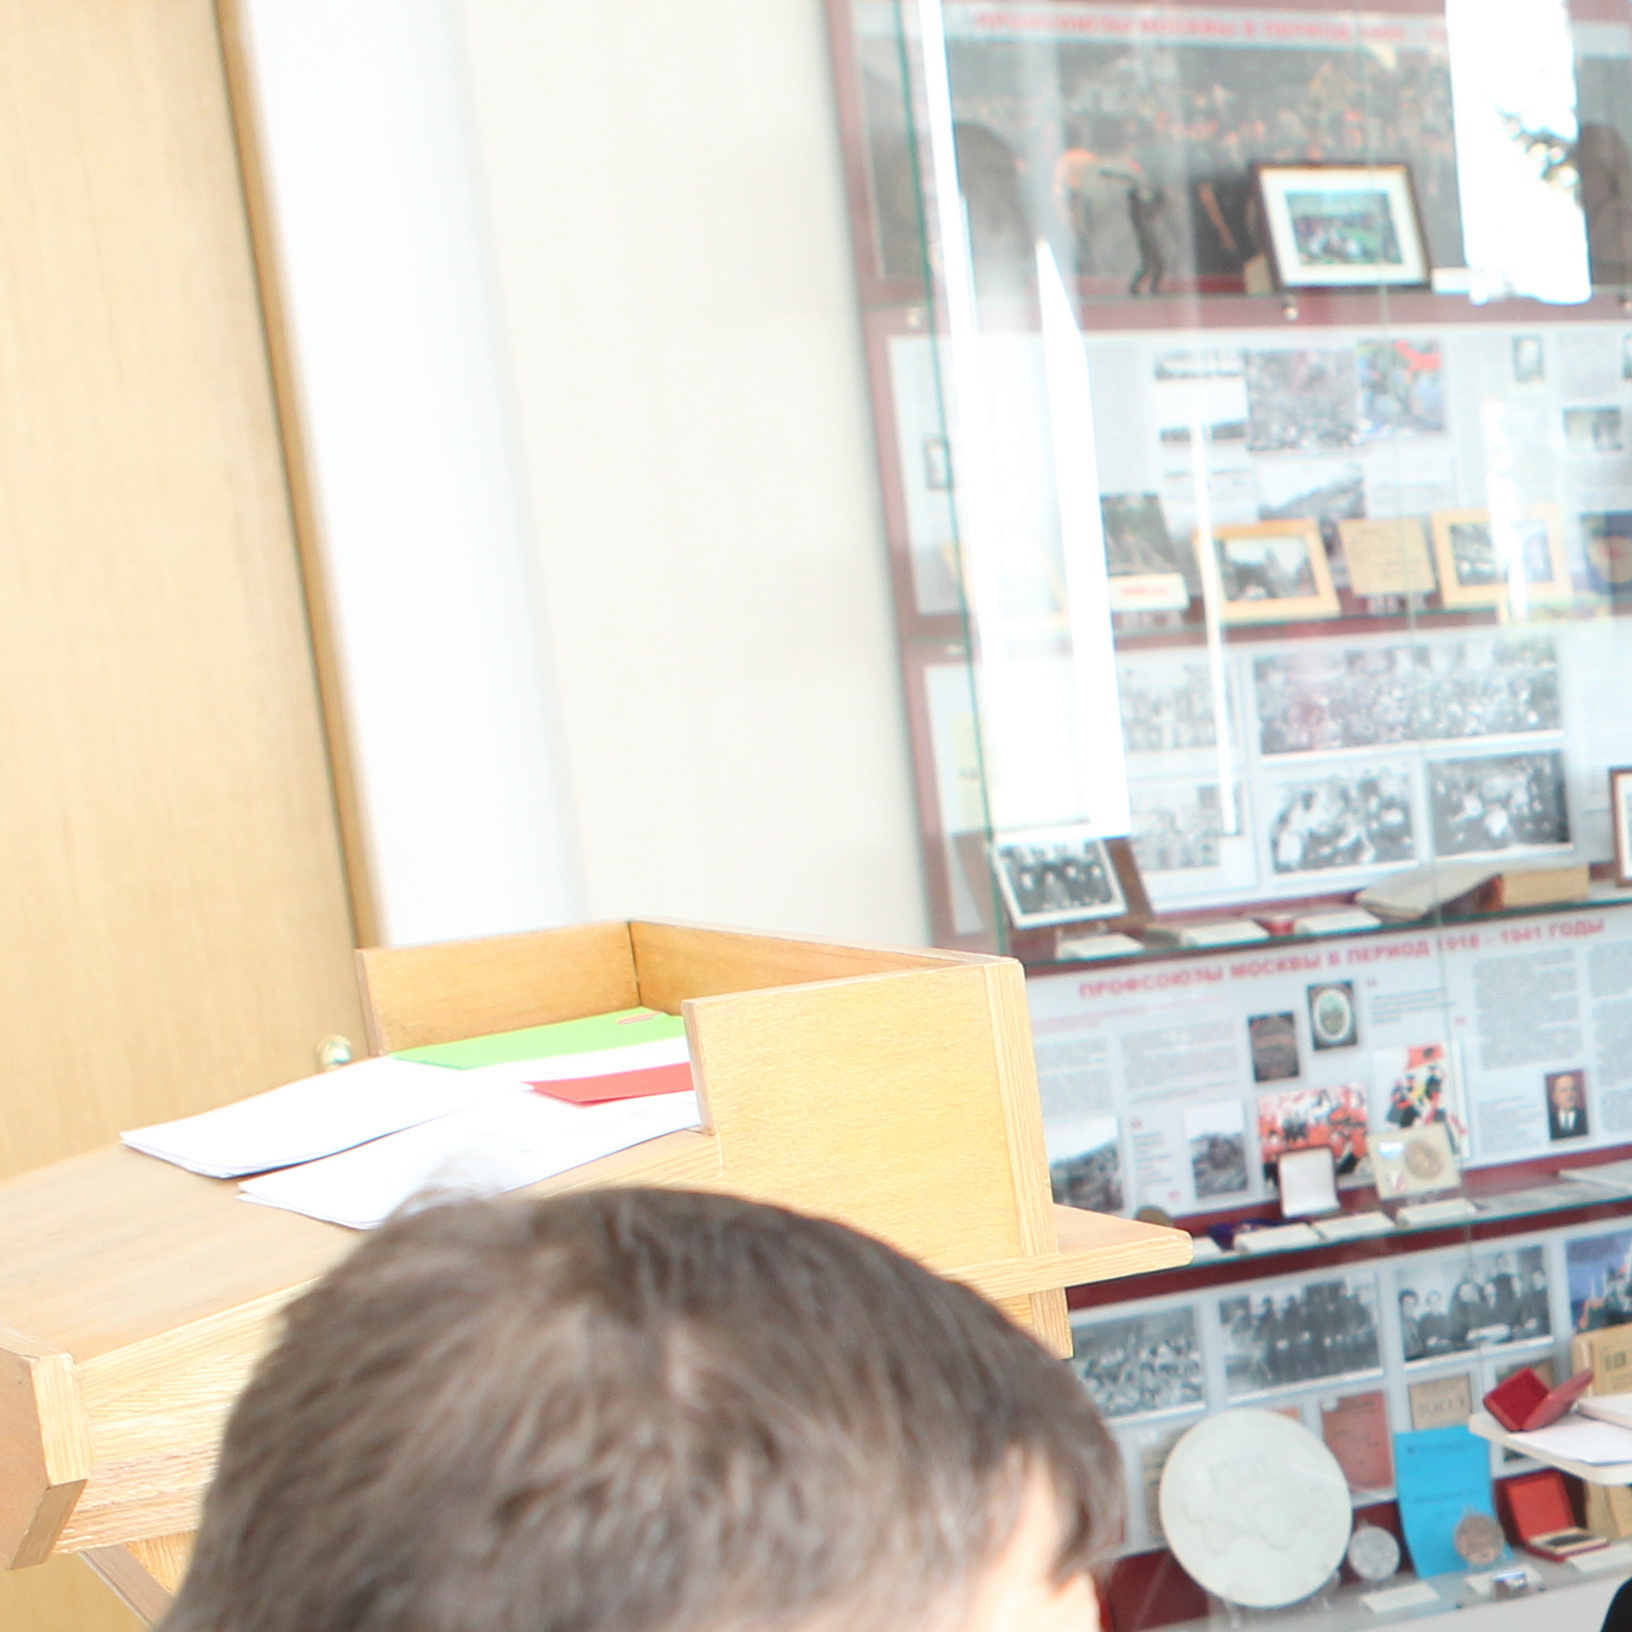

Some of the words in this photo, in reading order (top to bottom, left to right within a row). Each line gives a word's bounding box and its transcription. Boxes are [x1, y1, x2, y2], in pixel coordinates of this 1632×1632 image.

[1079, 966, 1224, 998] ПРОФСОЮЗЫ
[1231, 952, 1322, 979] МОСКВЫ
[1328, 951, 1340, 966] В
[1347, 939, 1431, 963] ПЕРИОД
[1550, 917, 1606, 938] ГОДЫ
